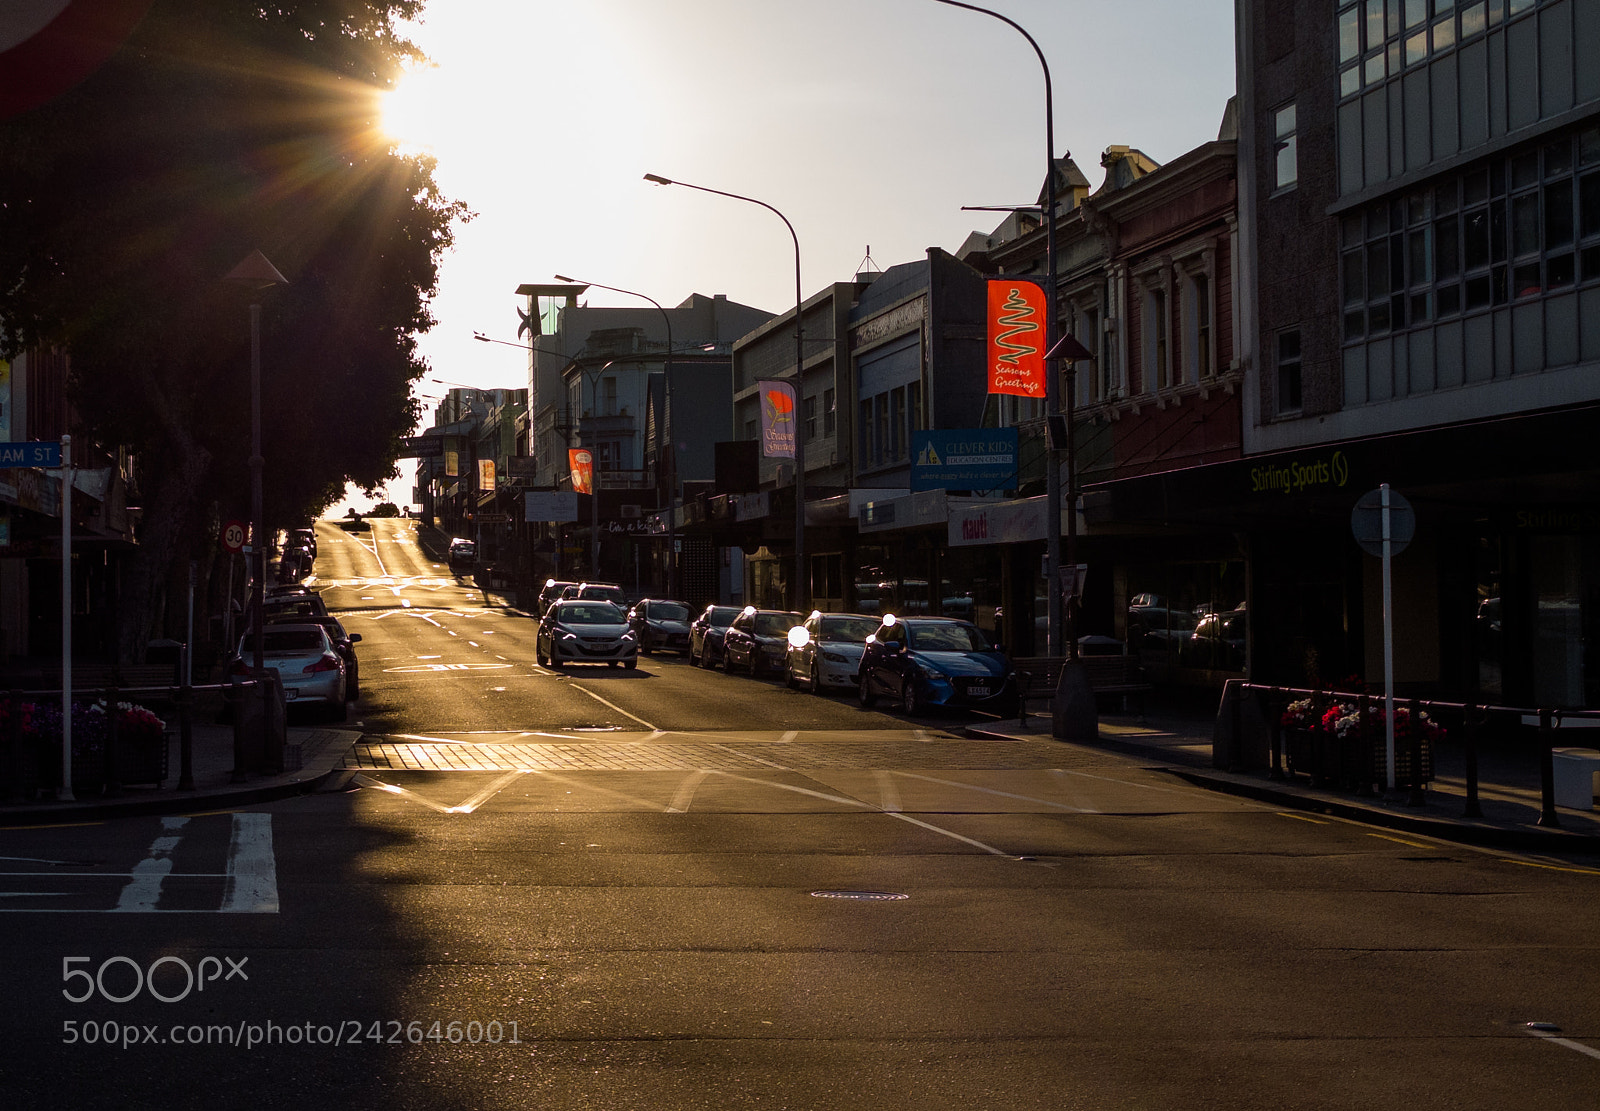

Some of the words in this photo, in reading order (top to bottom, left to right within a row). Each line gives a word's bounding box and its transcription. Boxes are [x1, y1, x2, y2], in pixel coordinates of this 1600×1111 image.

[995, 363, 1031, 376] Seasons
[995, 376, 1039, 393] Greetings
[946, 442, 985, 454] CLEVER
[988, 440, 1014, 453] KIDS
[0, 448, 24, 462] AM
[34, 448, 52, 462] ST
[947, 455, 984, 465] EDUCATION
[985, 454, 1012, 464] CENTRES
[1251, 465, 1290, 494] Stirling
[1292, 460, 1329, 491] Sports
[1516, 509, 1581, 531] Stirling
[227, 529, 242, 543] 30
